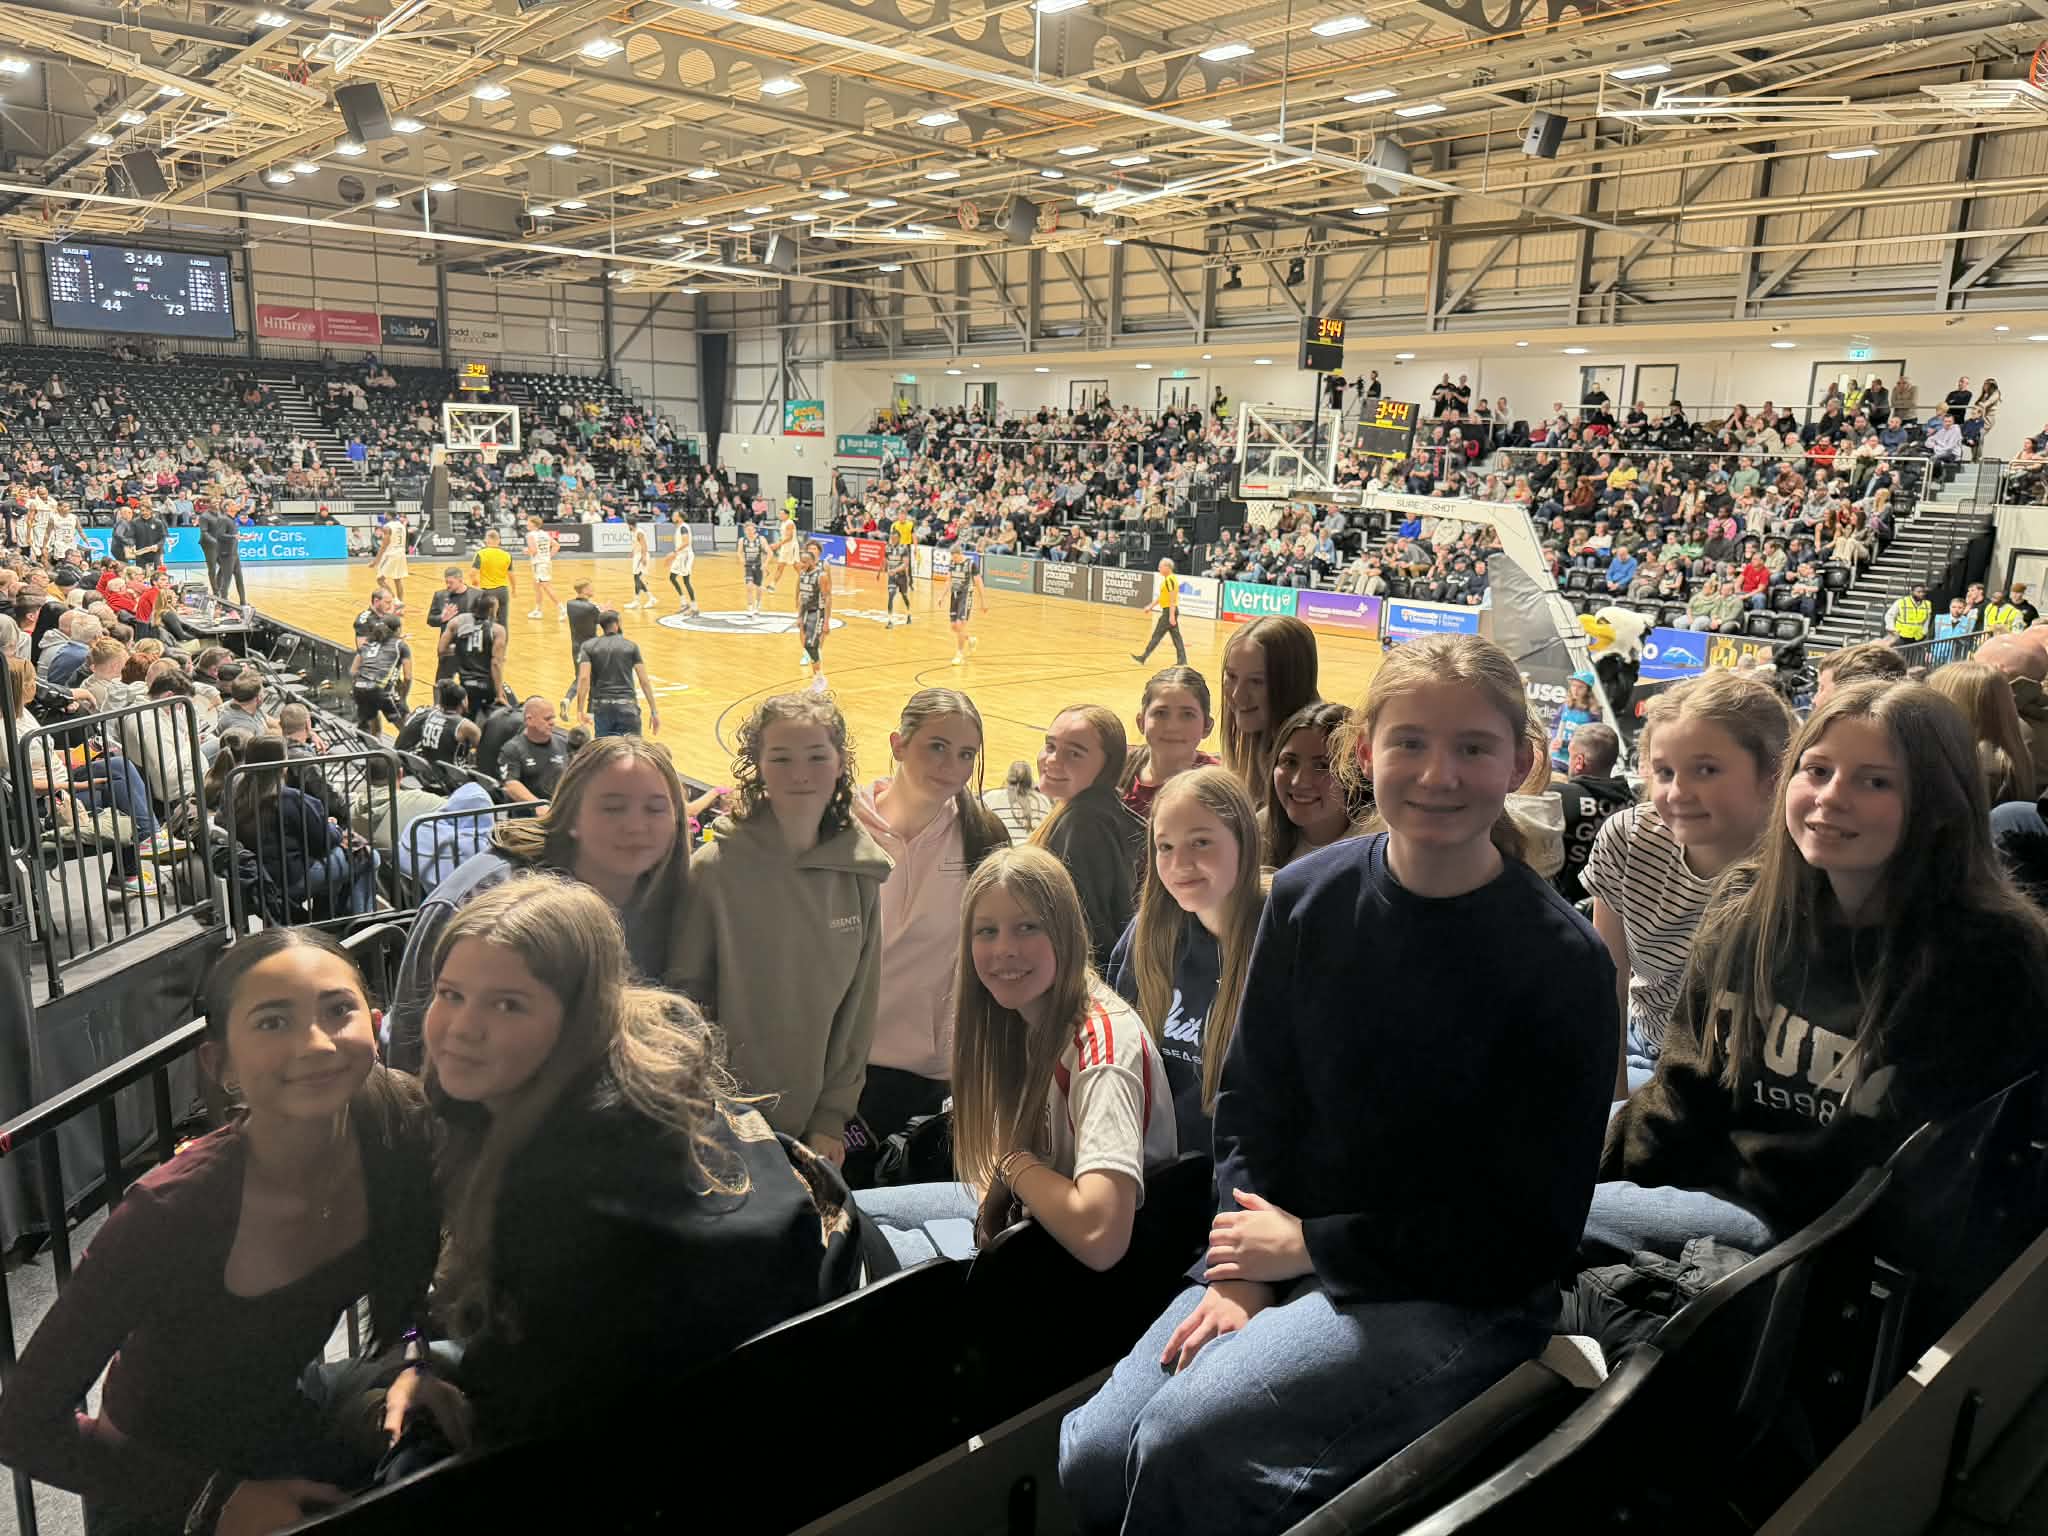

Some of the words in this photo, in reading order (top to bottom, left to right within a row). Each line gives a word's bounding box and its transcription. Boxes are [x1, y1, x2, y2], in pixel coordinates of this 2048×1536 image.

[124, 252, 164, 266] 3:44
[101, 299, 123, 313] 44
[165, 303, 186, 316] 73
[268, 529, 308, 543] Cars.
[239, 543, 269, 558] sed
[271, 544, 311, 558] Cars.
[1230, 587, 1282, 612] Vertu
[1752, 1079, 1838, 1127] 1998
